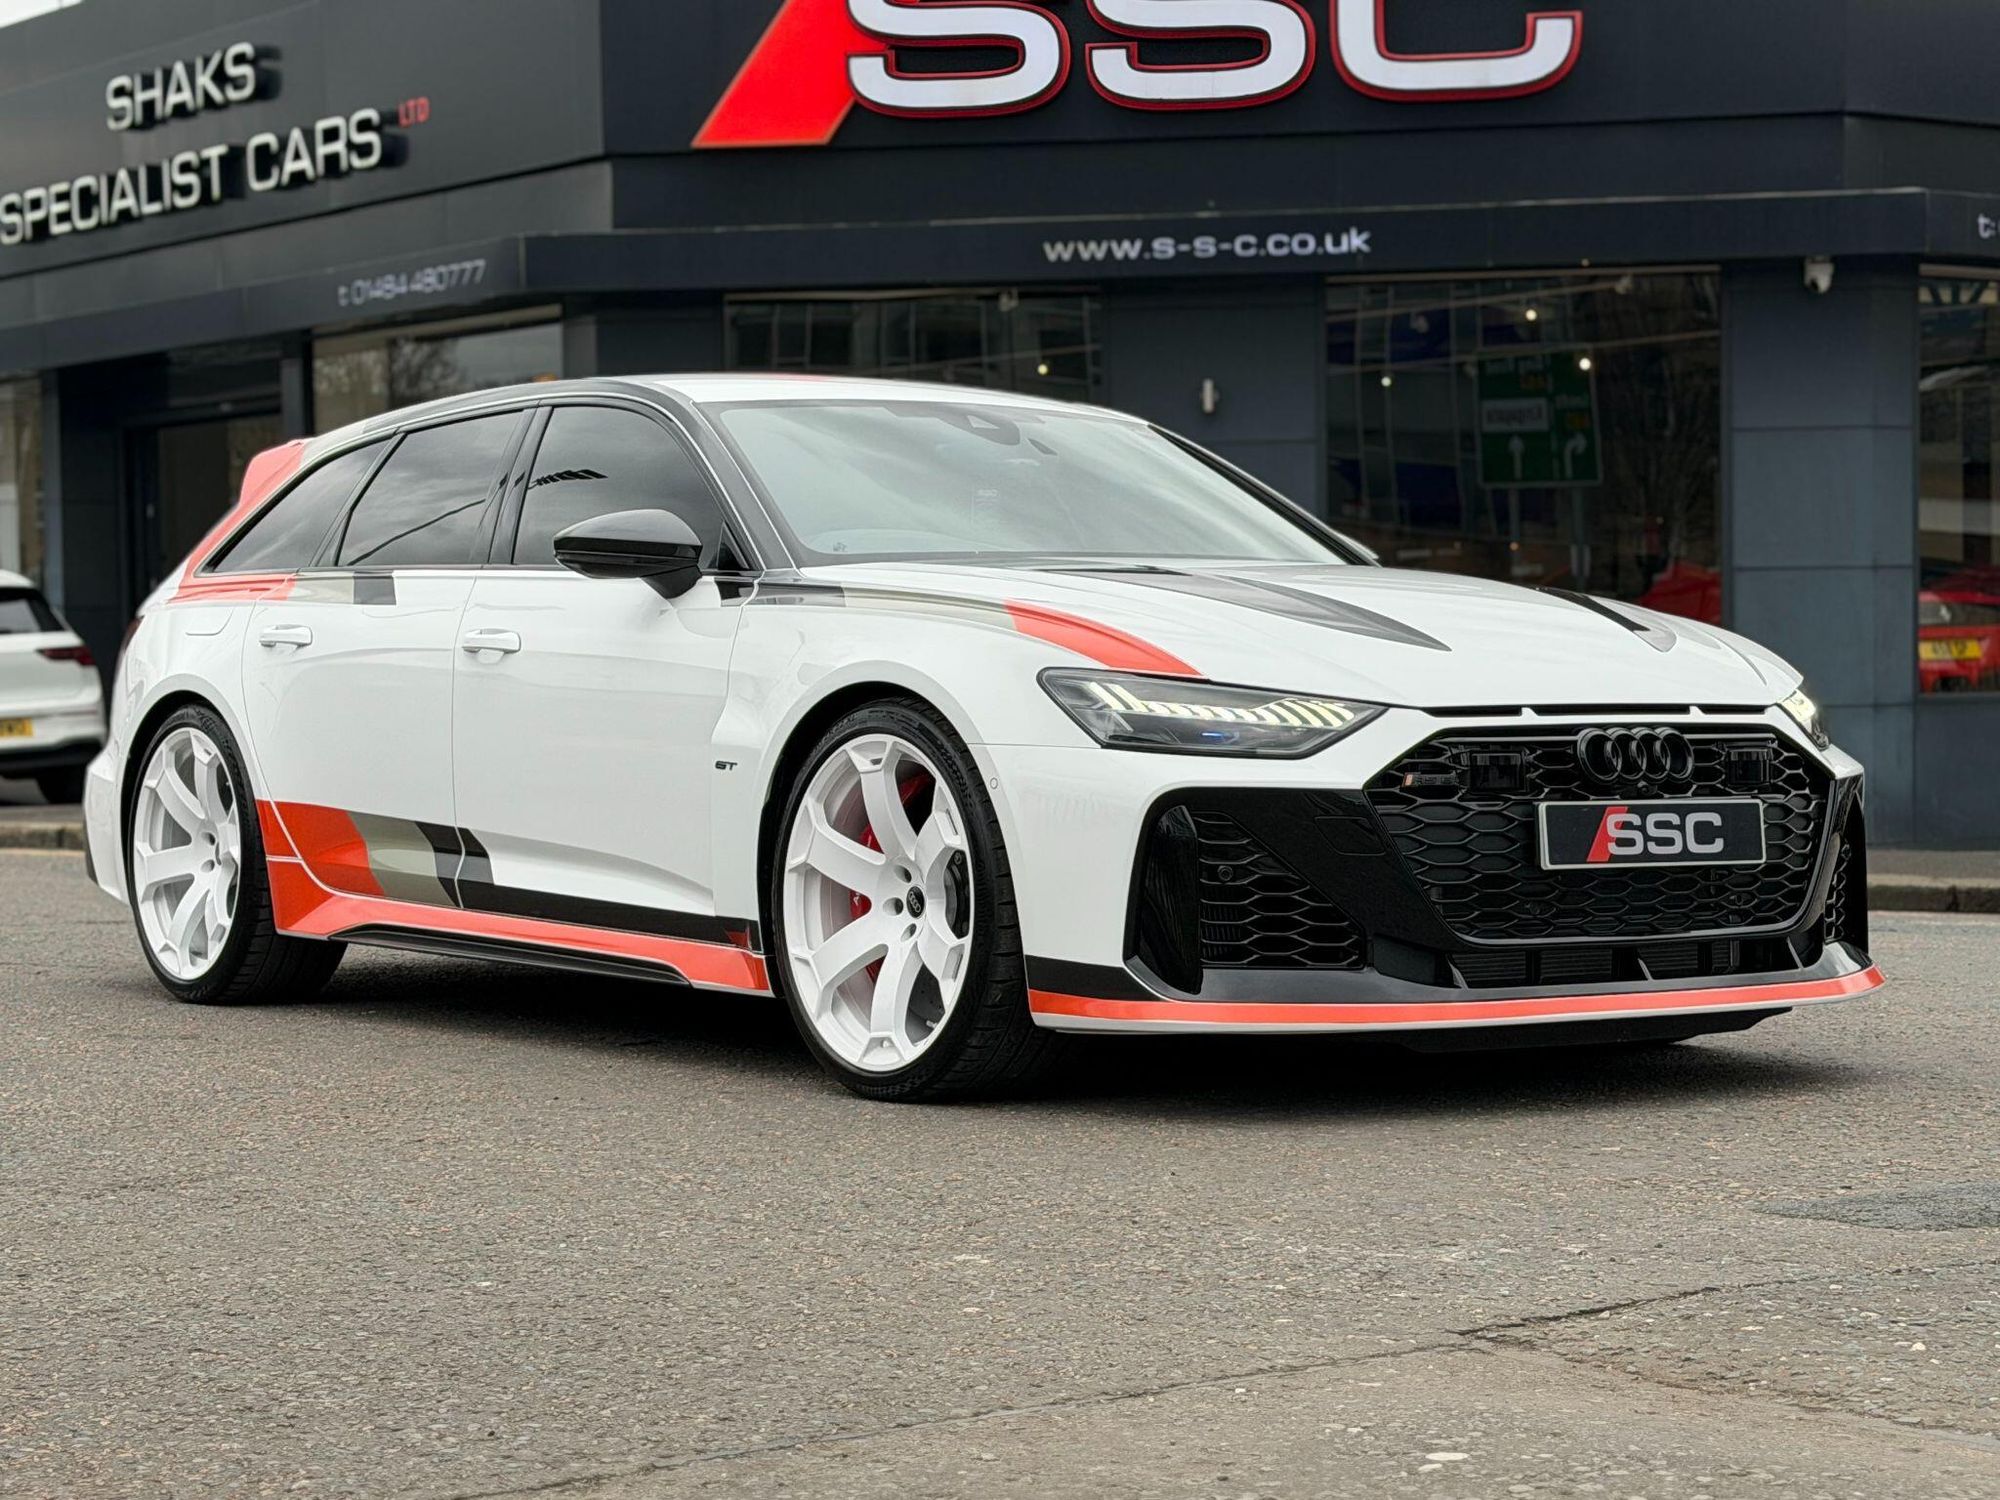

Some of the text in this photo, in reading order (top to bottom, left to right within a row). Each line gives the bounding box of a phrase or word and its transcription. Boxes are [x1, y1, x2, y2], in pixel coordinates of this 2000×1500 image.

[106, 42, 256, 131] SHAKS
[0, 97, 431, 246] SPECIALIST CARS LTD
[1043, 226, 1372, 262] www.s-s-c.co.uk
[715, 760, 738, 771] GT
[1606, 812, 1725, 856] SSC
